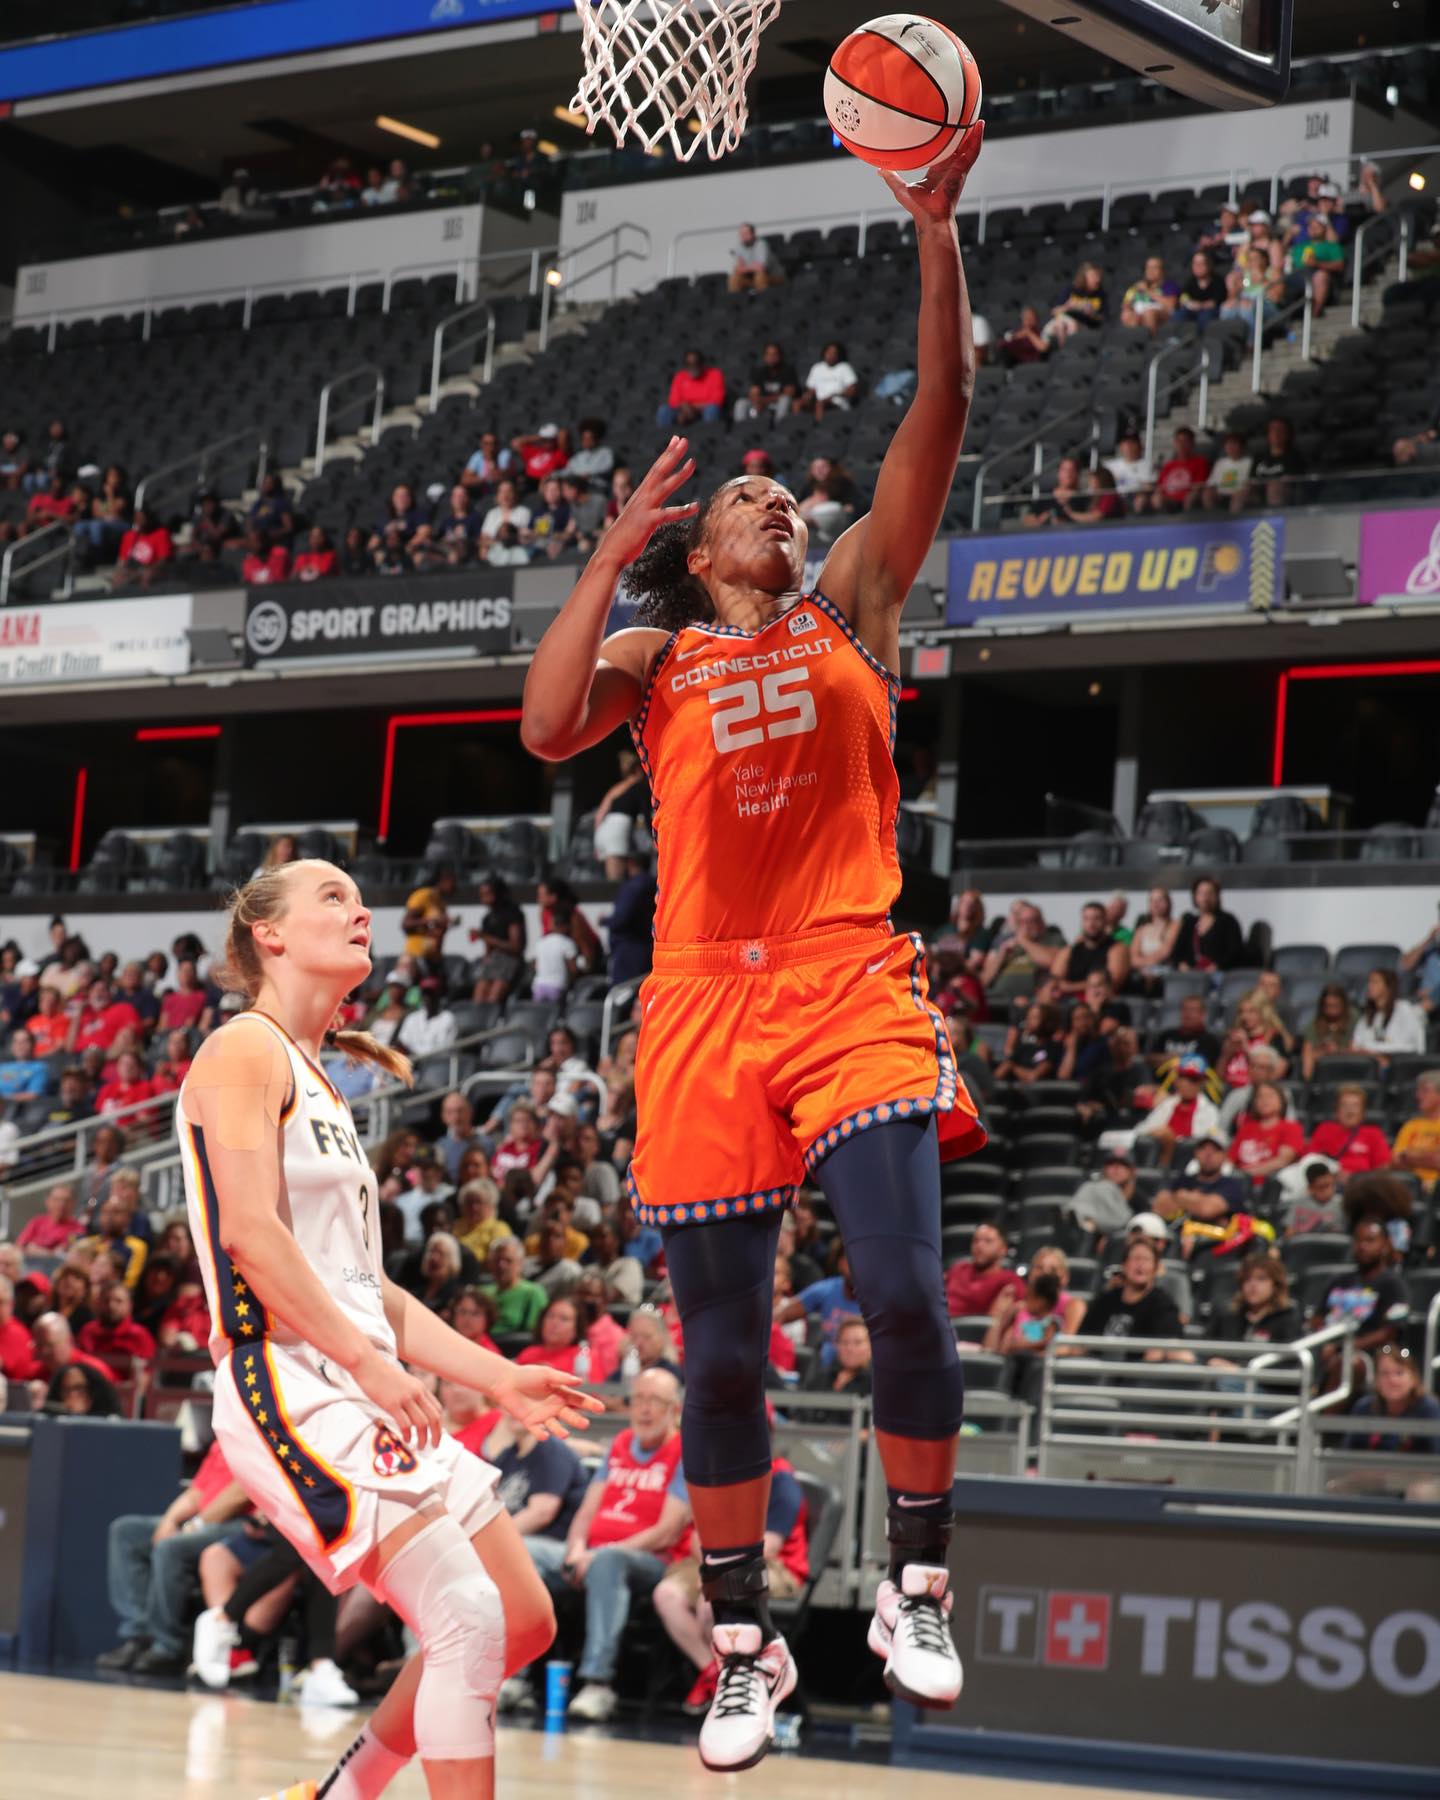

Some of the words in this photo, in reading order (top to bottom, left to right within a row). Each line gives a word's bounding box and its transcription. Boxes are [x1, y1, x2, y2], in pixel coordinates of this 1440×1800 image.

[968, 554, 1132, 602] REVVED
[1137, 548, 1198, 592] UP
[290, 606, 374, 641] SPORT
[379, 597, 512, 636] GRAPHICS
[671, 638, 833, 693] CONNECTICUT
[708, 666, 818, 754] 25
[732, 763, 765, 782] Yale
[737, 793, 790, 818] Health
[613, 1488, 637, 1513] 2
[1119, 1593, 1440, 1696] TISSO
